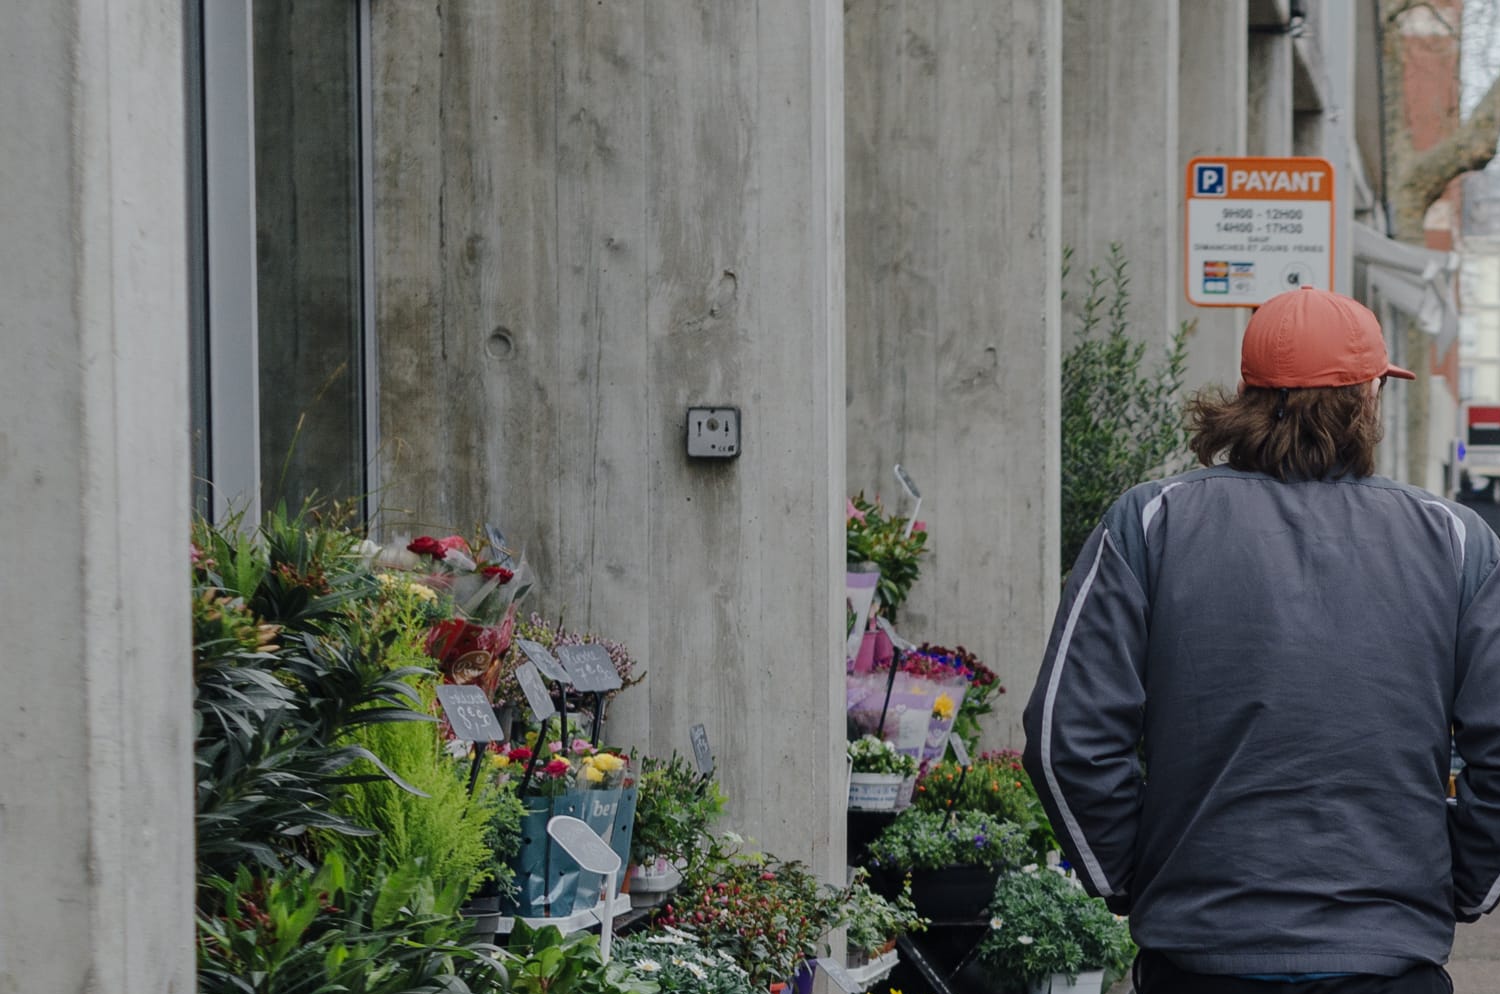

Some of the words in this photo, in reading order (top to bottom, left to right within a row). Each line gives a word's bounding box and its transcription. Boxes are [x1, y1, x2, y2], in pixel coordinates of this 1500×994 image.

[1231, 170, 1325, 192] PAYANT
[1222, 208, 1253, 219] 9H00
[1266, 209, 1303, 220] 12H00
[1216, 222, 1253, 233] 14H00
